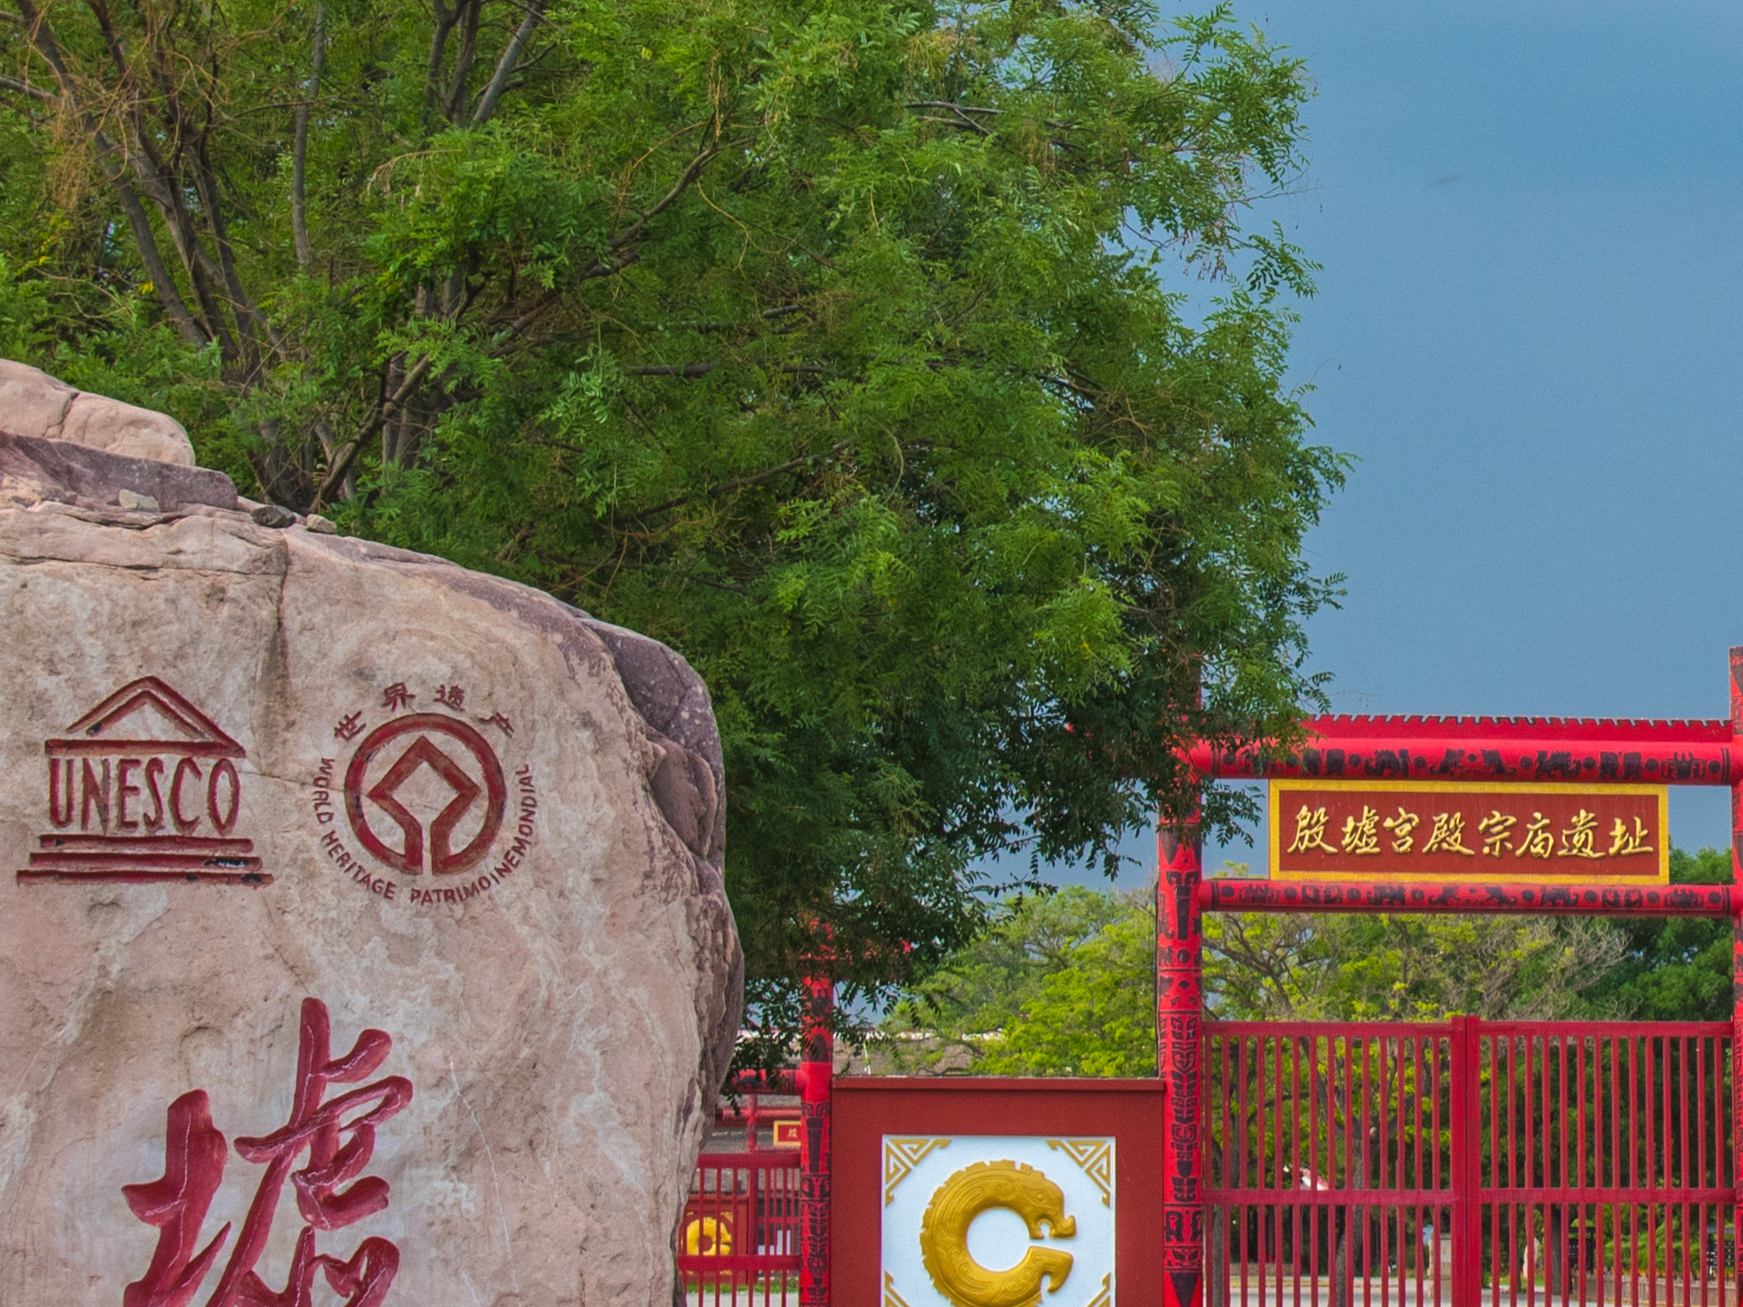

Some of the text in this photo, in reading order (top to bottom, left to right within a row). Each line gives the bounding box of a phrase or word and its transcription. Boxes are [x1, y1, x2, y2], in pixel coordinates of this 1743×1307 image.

[333, 682, 515, 742] 世界遗产
[48, 756, 242, 835] UNESCO
[313, 756, 398, 901] WORLD HERITAGE
